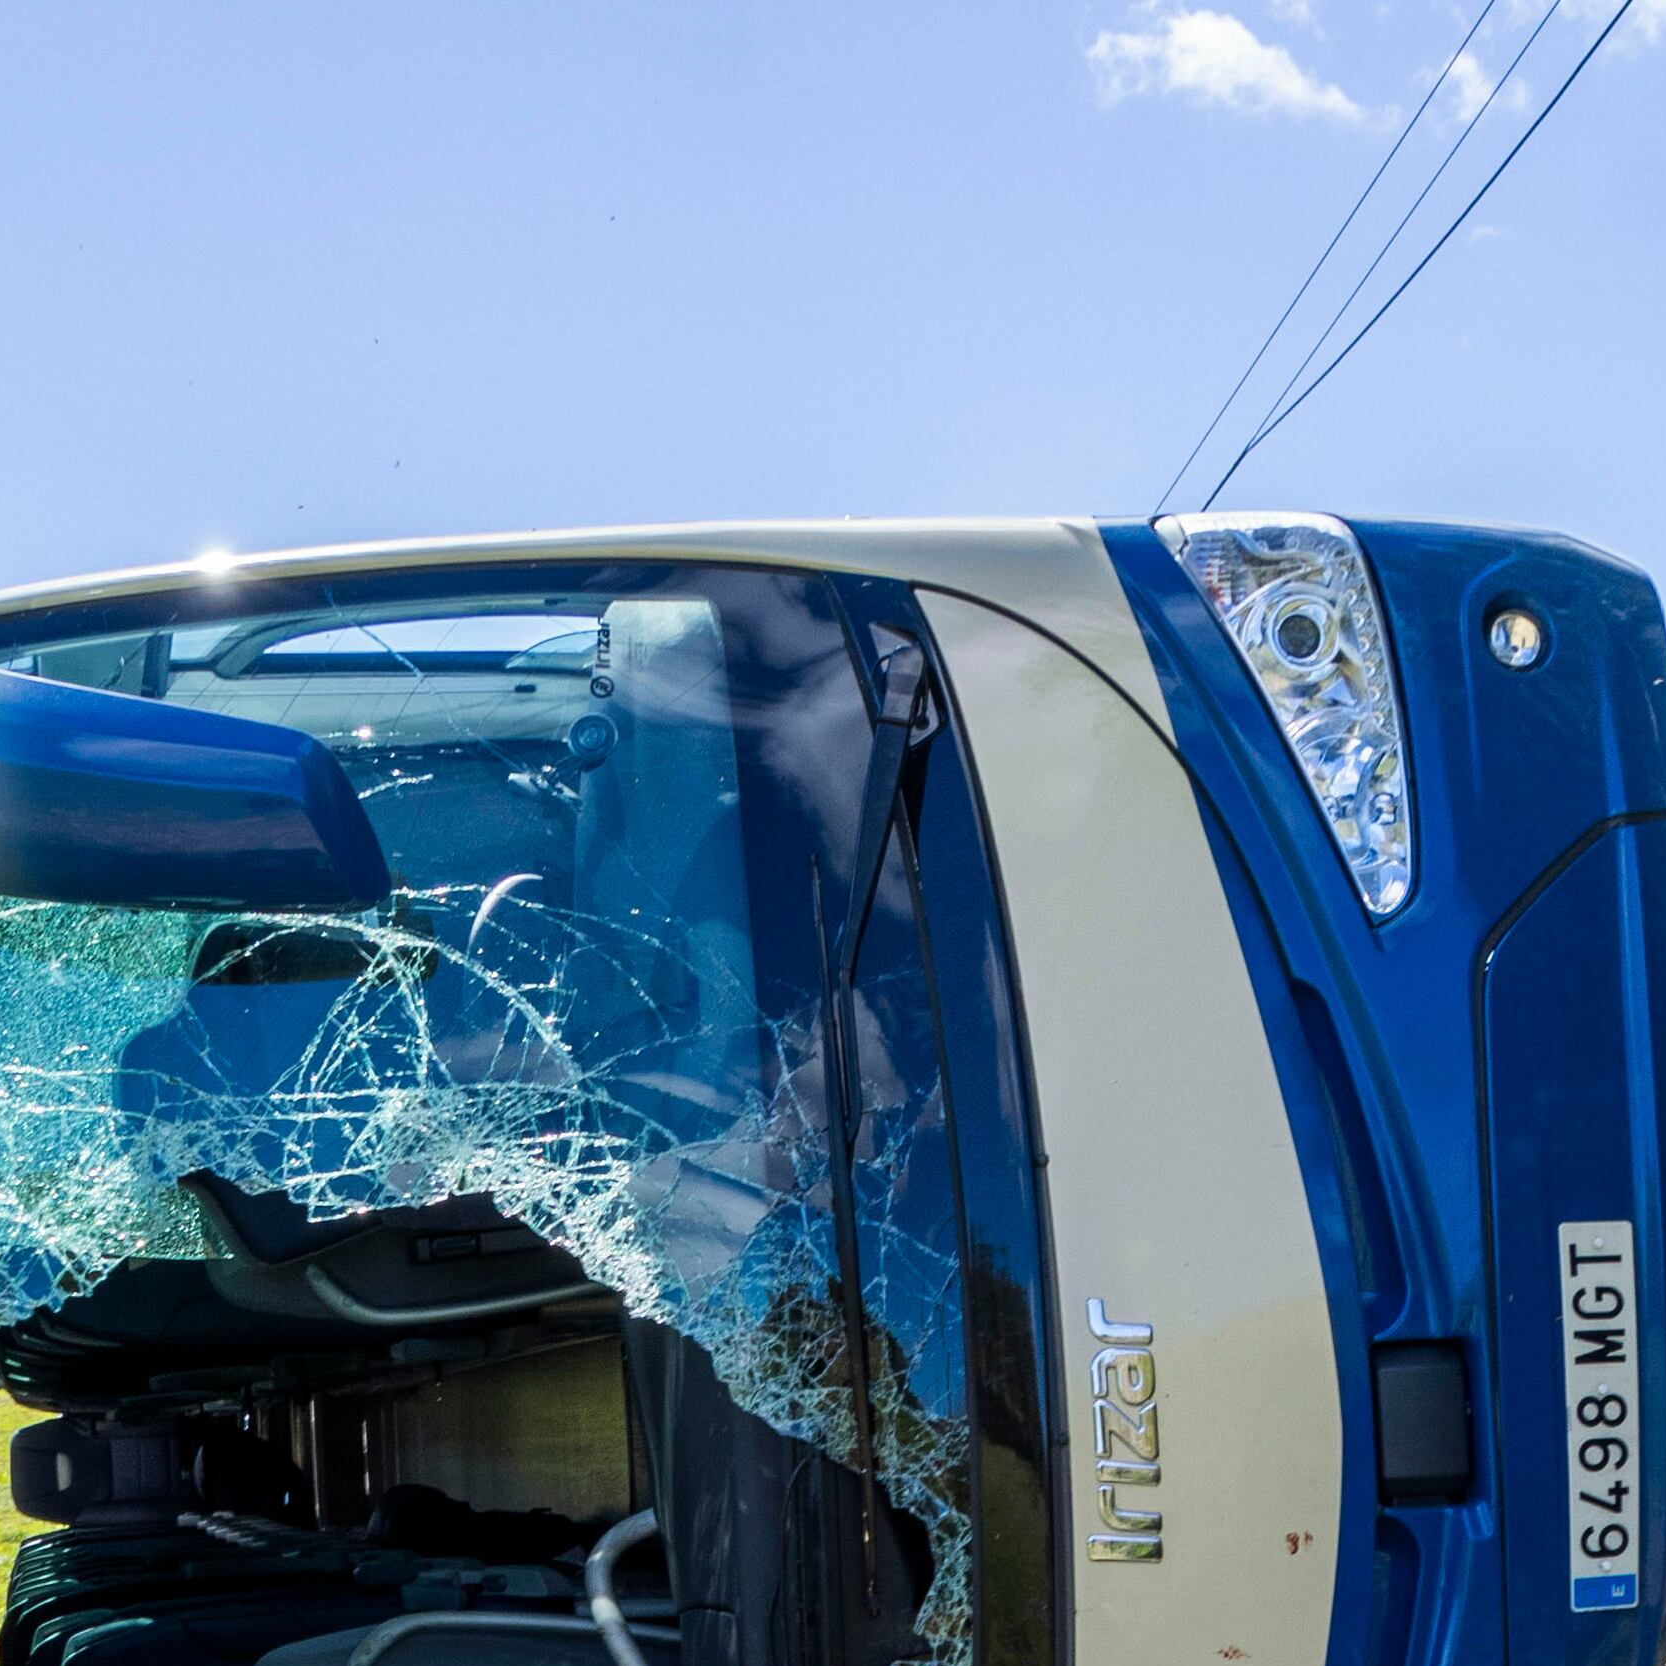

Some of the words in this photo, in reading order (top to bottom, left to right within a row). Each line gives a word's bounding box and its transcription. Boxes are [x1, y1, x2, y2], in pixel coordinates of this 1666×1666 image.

[1569, 1243, 1626, 1365] MGT
[1086, 1297, 1163, 1563] Irizar
[1577, 1394, 1629, 1559] 6498
[1611, 1584, 1626, 1597] E
